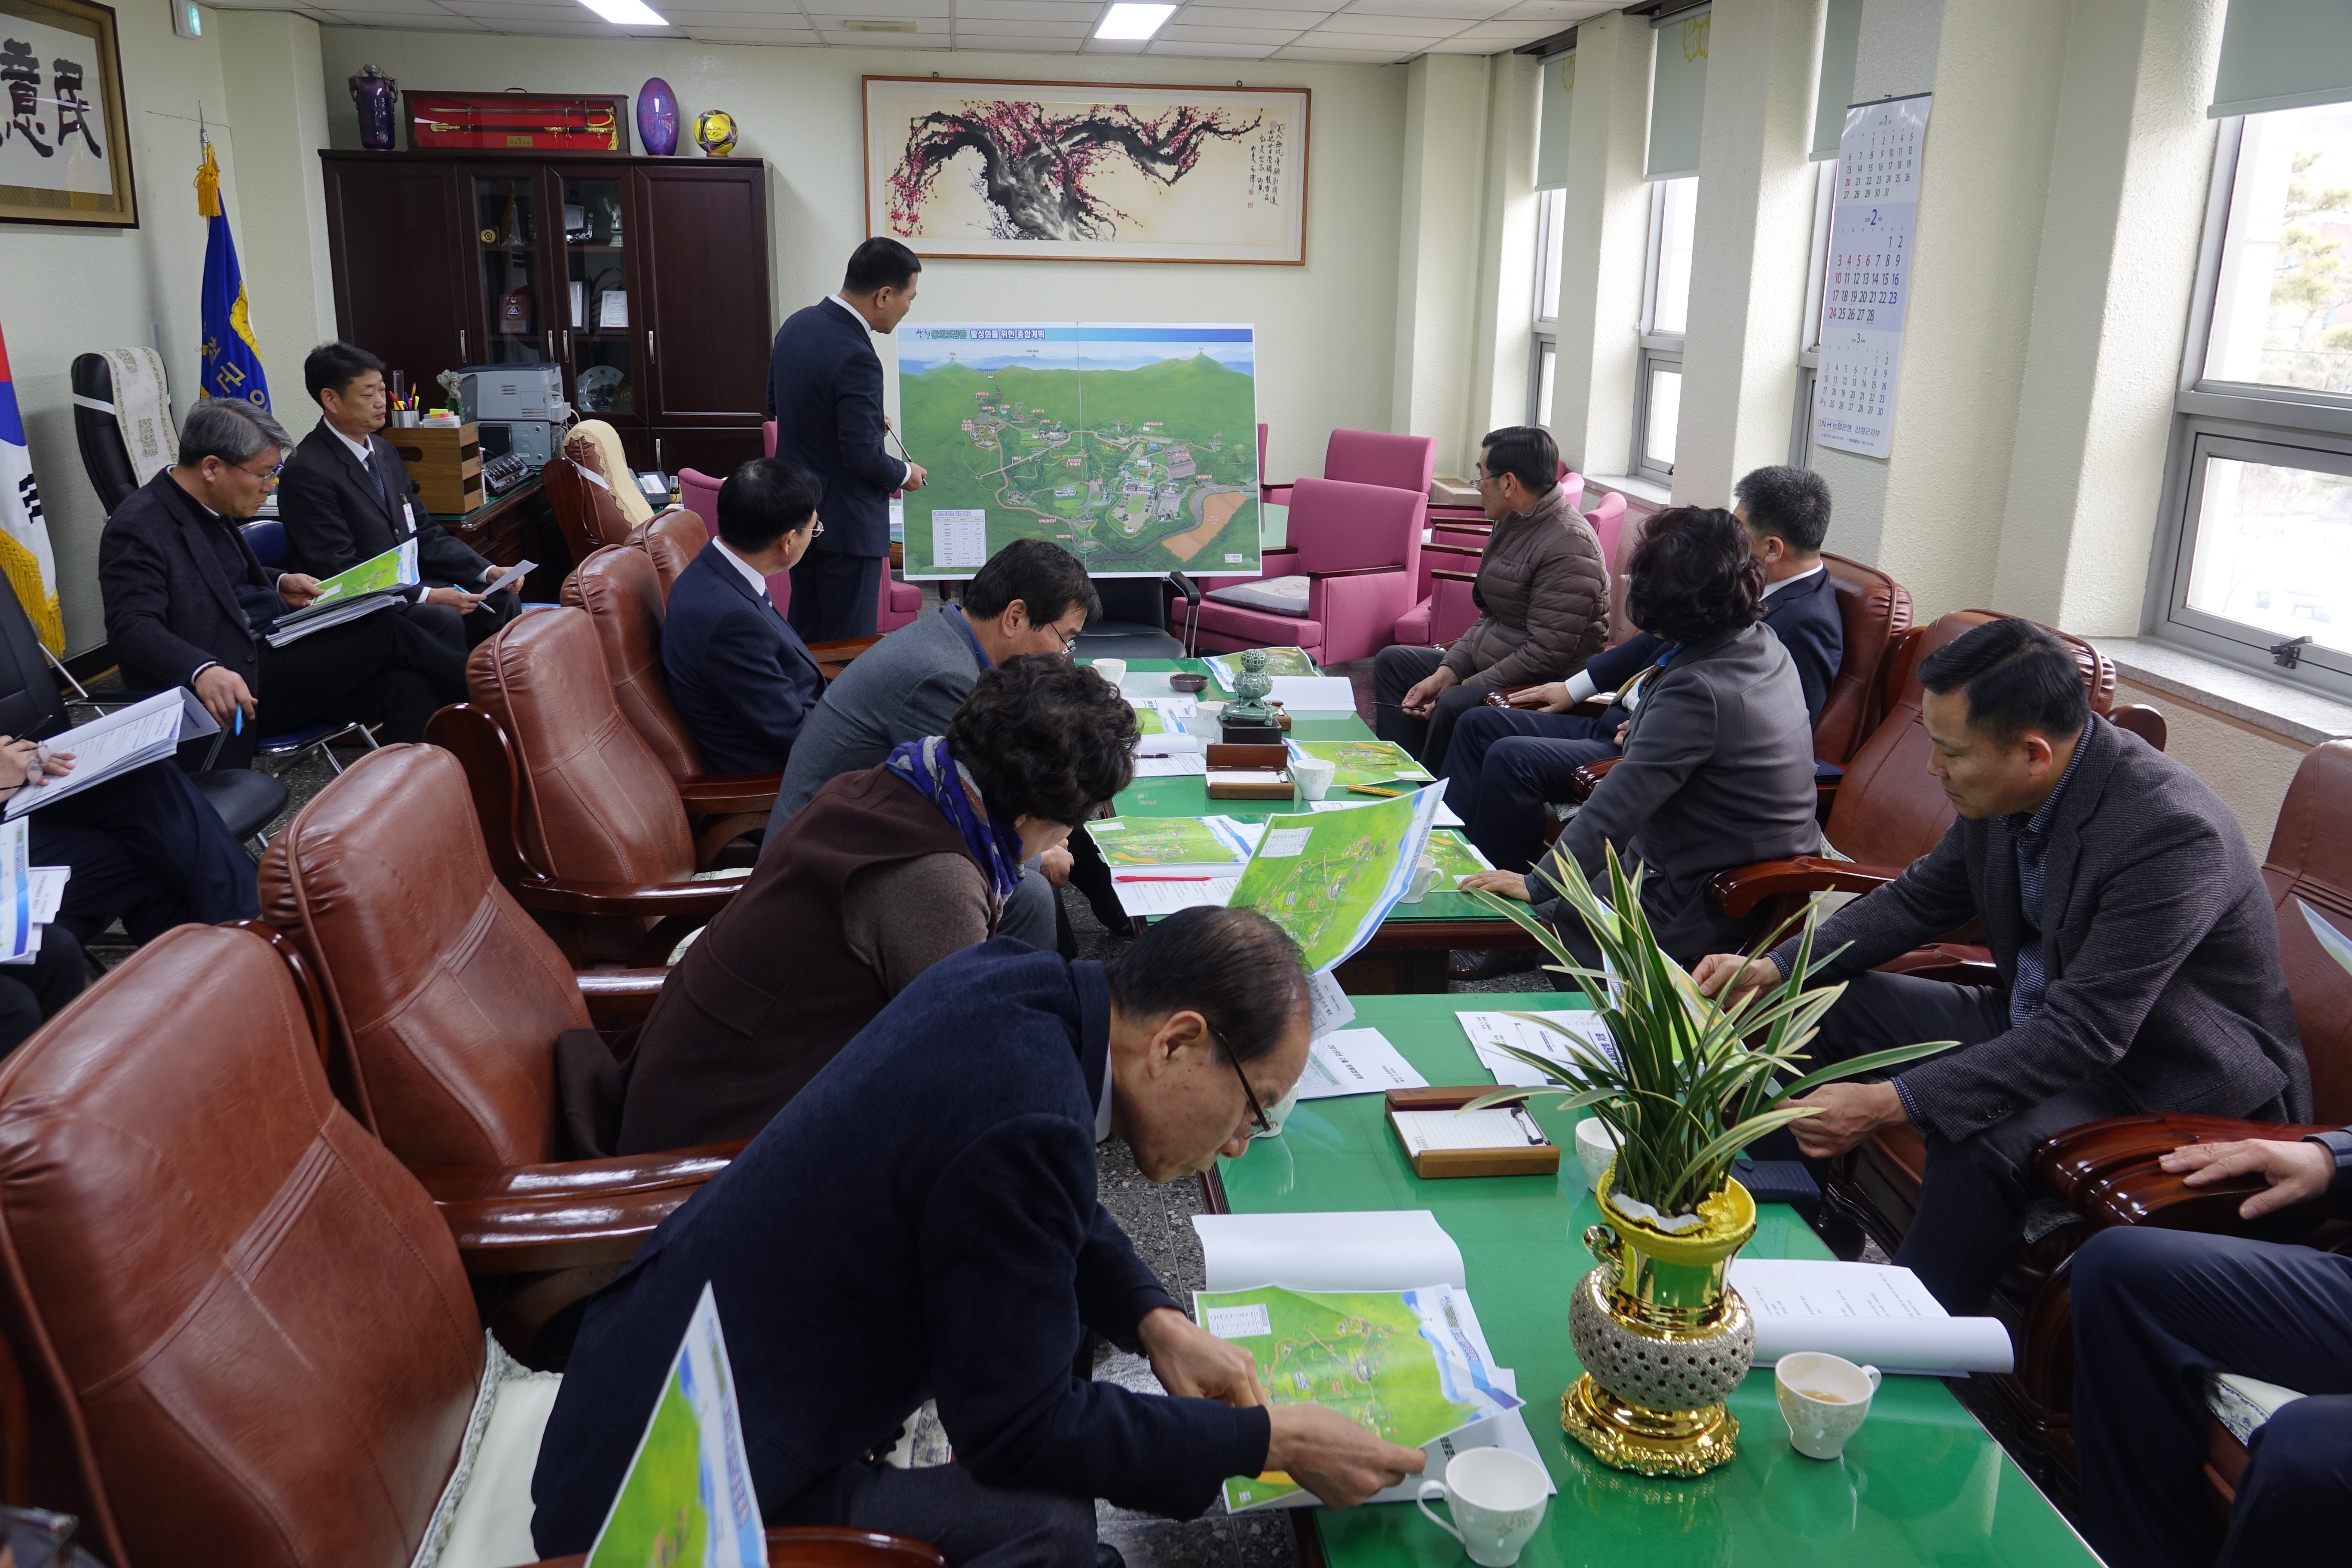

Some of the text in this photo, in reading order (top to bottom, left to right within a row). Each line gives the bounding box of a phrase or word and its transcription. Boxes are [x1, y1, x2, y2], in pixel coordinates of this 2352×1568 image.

[0, 37, 102, 159] 民意
[1884, 115, 1887, 126] 1
[1872, 132, 1913, 146] 1 2 3 4 5
[1899, 147, 1902, 156] 11
[1908, 146, 1912, 154] 12
[1868, 164, 1873, 172] 15
[1889, 162, 1893, 170] 17
[1898, 161, 1902, 169] 18
[1907, 159, 1911, 168] 19
[1856, 178, 1860, 186] 21
[1876, 176, 1881, 184] 23
[1886, 175, 1891, 183] 24
[1896, 174, 1900, 182] 25
[1905, 173, 1910, 181] 26
[1865, 190, 1870, 198] 29
[1874, 189, 1880, 197] 30
[1884, 188, 1889, 196] 31
[1870, 209, 1877, 225] 2
[1890, 236, 1903, 248] 1 2
[1838, 254, 1900, 267] 3 4 5 6 7 8 9
[1835, 273, 1899, 285] 10 11 12 13 14 15 16
[1833, 290, 1897, 304] 17 18 19 20 21 22 23
[1829, 307, 1874, 321] 24 25 26 27 28
[931, 330, 967, 339] 동의보감촌
[970, 329, 999, 339] 활성화를
[1001, 329, 1015, 339] 위한
[1017, 329, 1046, 339] 종합계획
[1857, 333, 1860, 343] 3
[1885, 357, 1888, 365] 2
[1862, 380, 1866, 388] 14
[1882, 382, 1886, 390] 16
[1859, 392, 1865, 400] 21
[1869, 393, 1875, 401] 22
[1879, 395, 1885, 403] 23
[1868, 406, 1873, 414] 29
[1877, 407, 1883, 416] 30
[1595, 1033, 1607, 1041] 자료
[1328, 1044, 1343, 1057] 2019년
